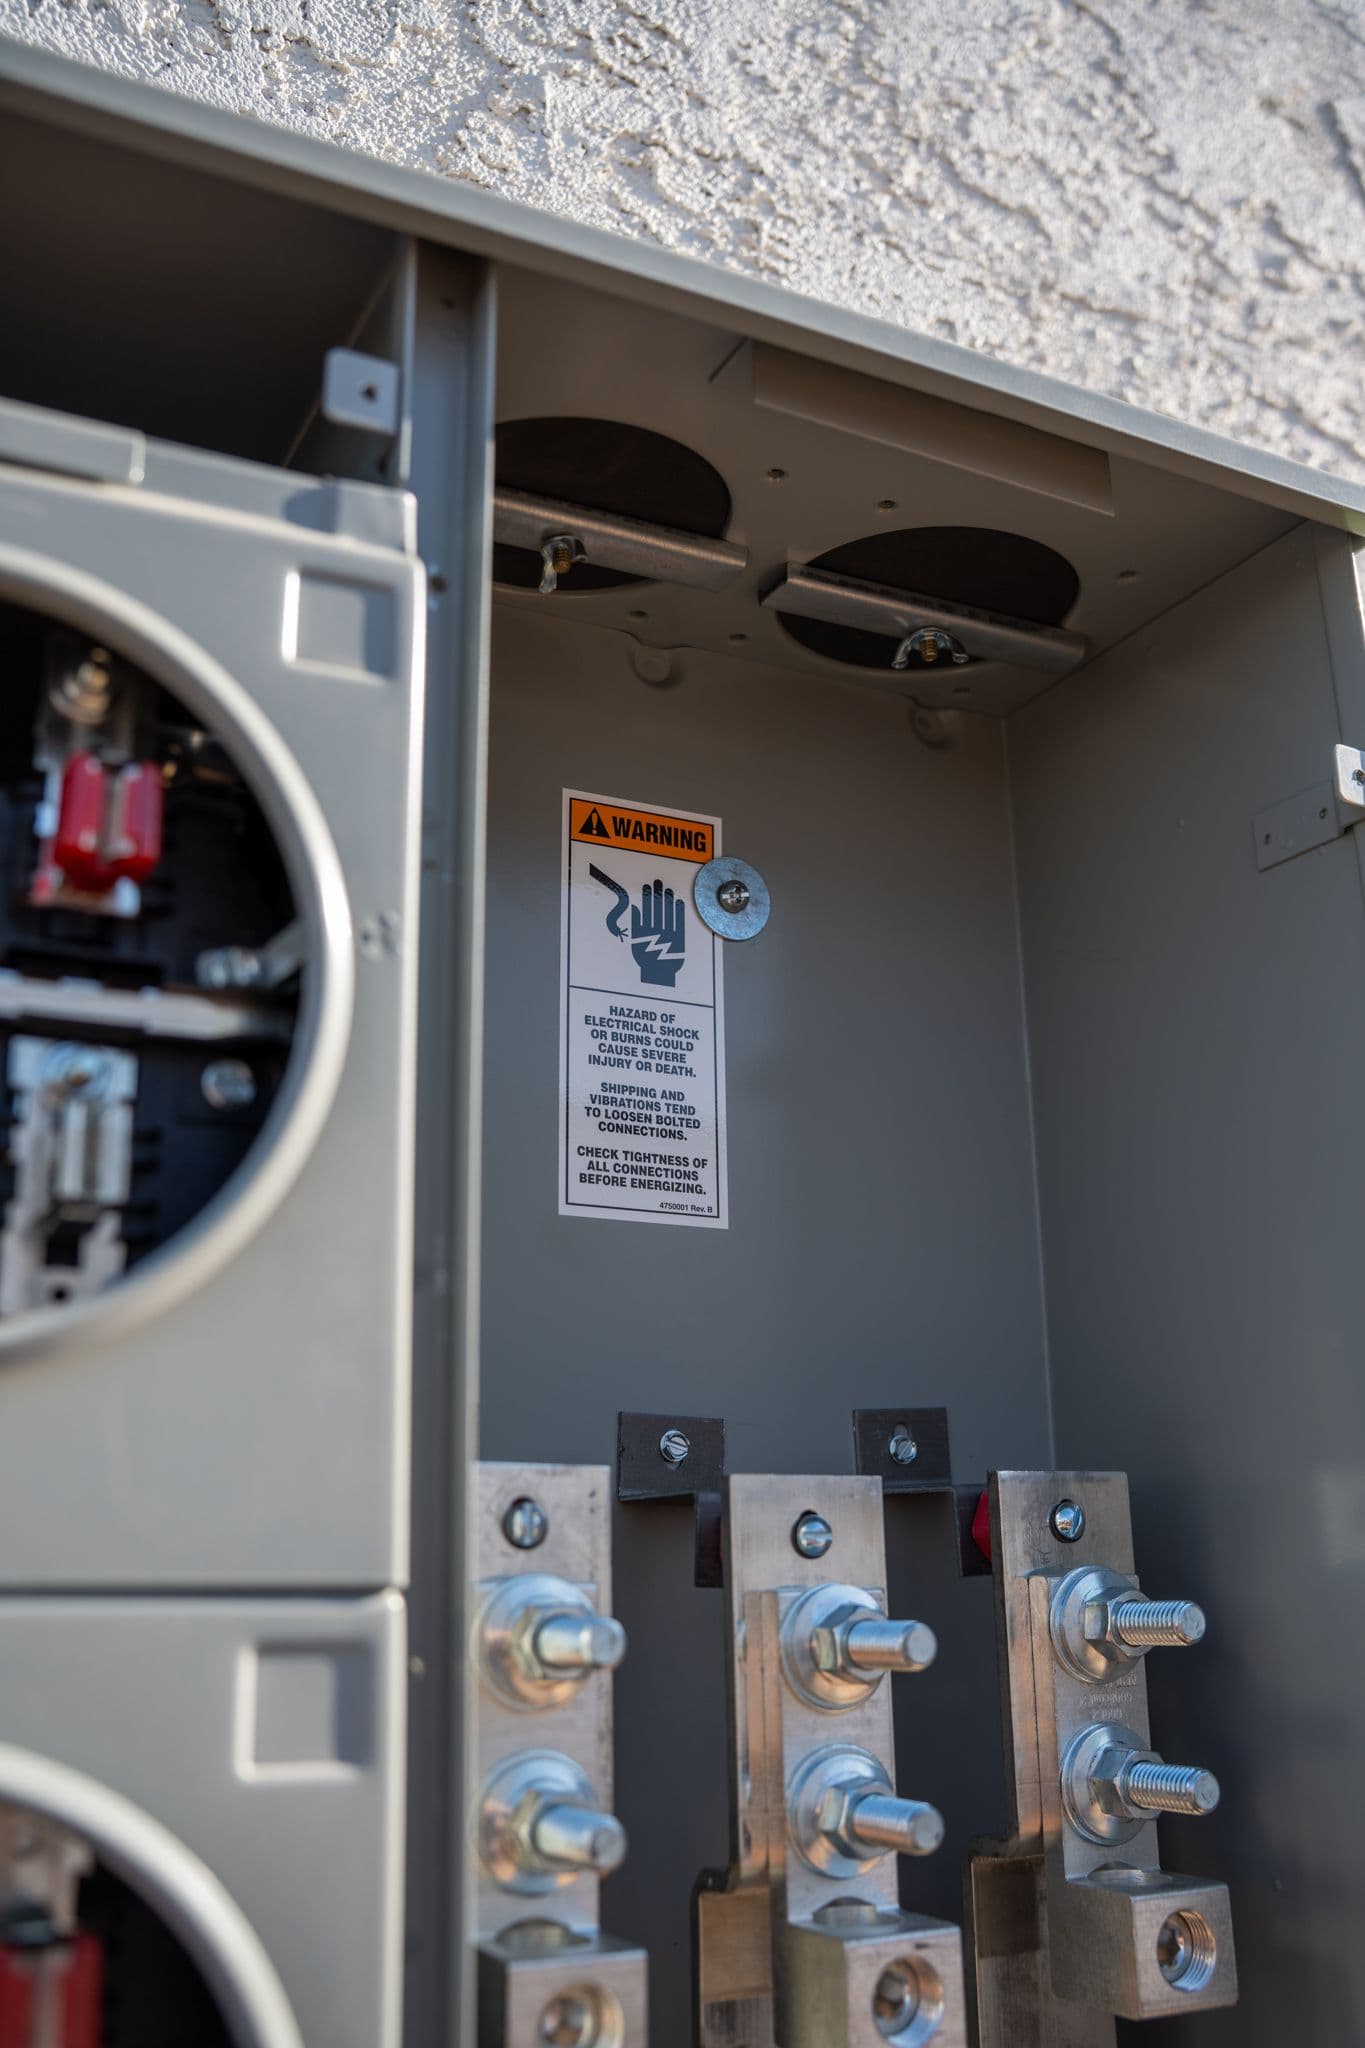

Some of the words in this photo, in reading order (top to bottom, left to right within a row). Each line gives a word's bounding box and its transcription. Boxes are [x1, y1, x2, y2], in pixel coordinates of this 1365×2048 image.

[612, 816, 707, 852] WARNING
[609, 1005, 657, 1022] HAZARD
[660, 1013, 676, 1024] OF
[584, 1015, 656, 1034] ELECTRICAL
[659, 1026, 700, 1040] SHOCK
[591, 1029, 608, 1040] OR
[611, 1032, 651, 1046] BURNS
[654, 1038, 694, 1051] COULD
[598, 1043, 638, 1057] CAUSE
[641, 1049, 686, 1063] SEVERE
[588, 1054, 632, 1069] INJURY
[635, 1061, 652, 1072] OR
[655, 1063, 697, 1077] DEATH.
[601, 1082, 657, 1098] SHIPPING
[660, 1090, 685, 1101] AND
[590, 1094, 661, 1112] VIBRATIONS
[665, 1103, 696, 1115] TEND
[584, 1106, 601, 1117] TO
[605, 1109, 652, 1123] LOOSEN
[656, 1115, 701, 1129] BOLTED
[598, 1121, 688, 1140] CONNECTIONS.
[577, 1145, 619, 1160] CHECK
[622, 1151, 690, 1166] TIGHTNESS
[693, 1158, 708, 1169] OF
[587, 1161, 610, 1172] ALL
[613, 1163, 699, 1181] CONNECTIONS
[579, 1173, 627, 1187] BEFORE
[630, 1178, 707, 1195] ENERGIZING.
[660, 1202, 688, 1211] 4750001
[691, 1204, 706, 1213] Rev.
